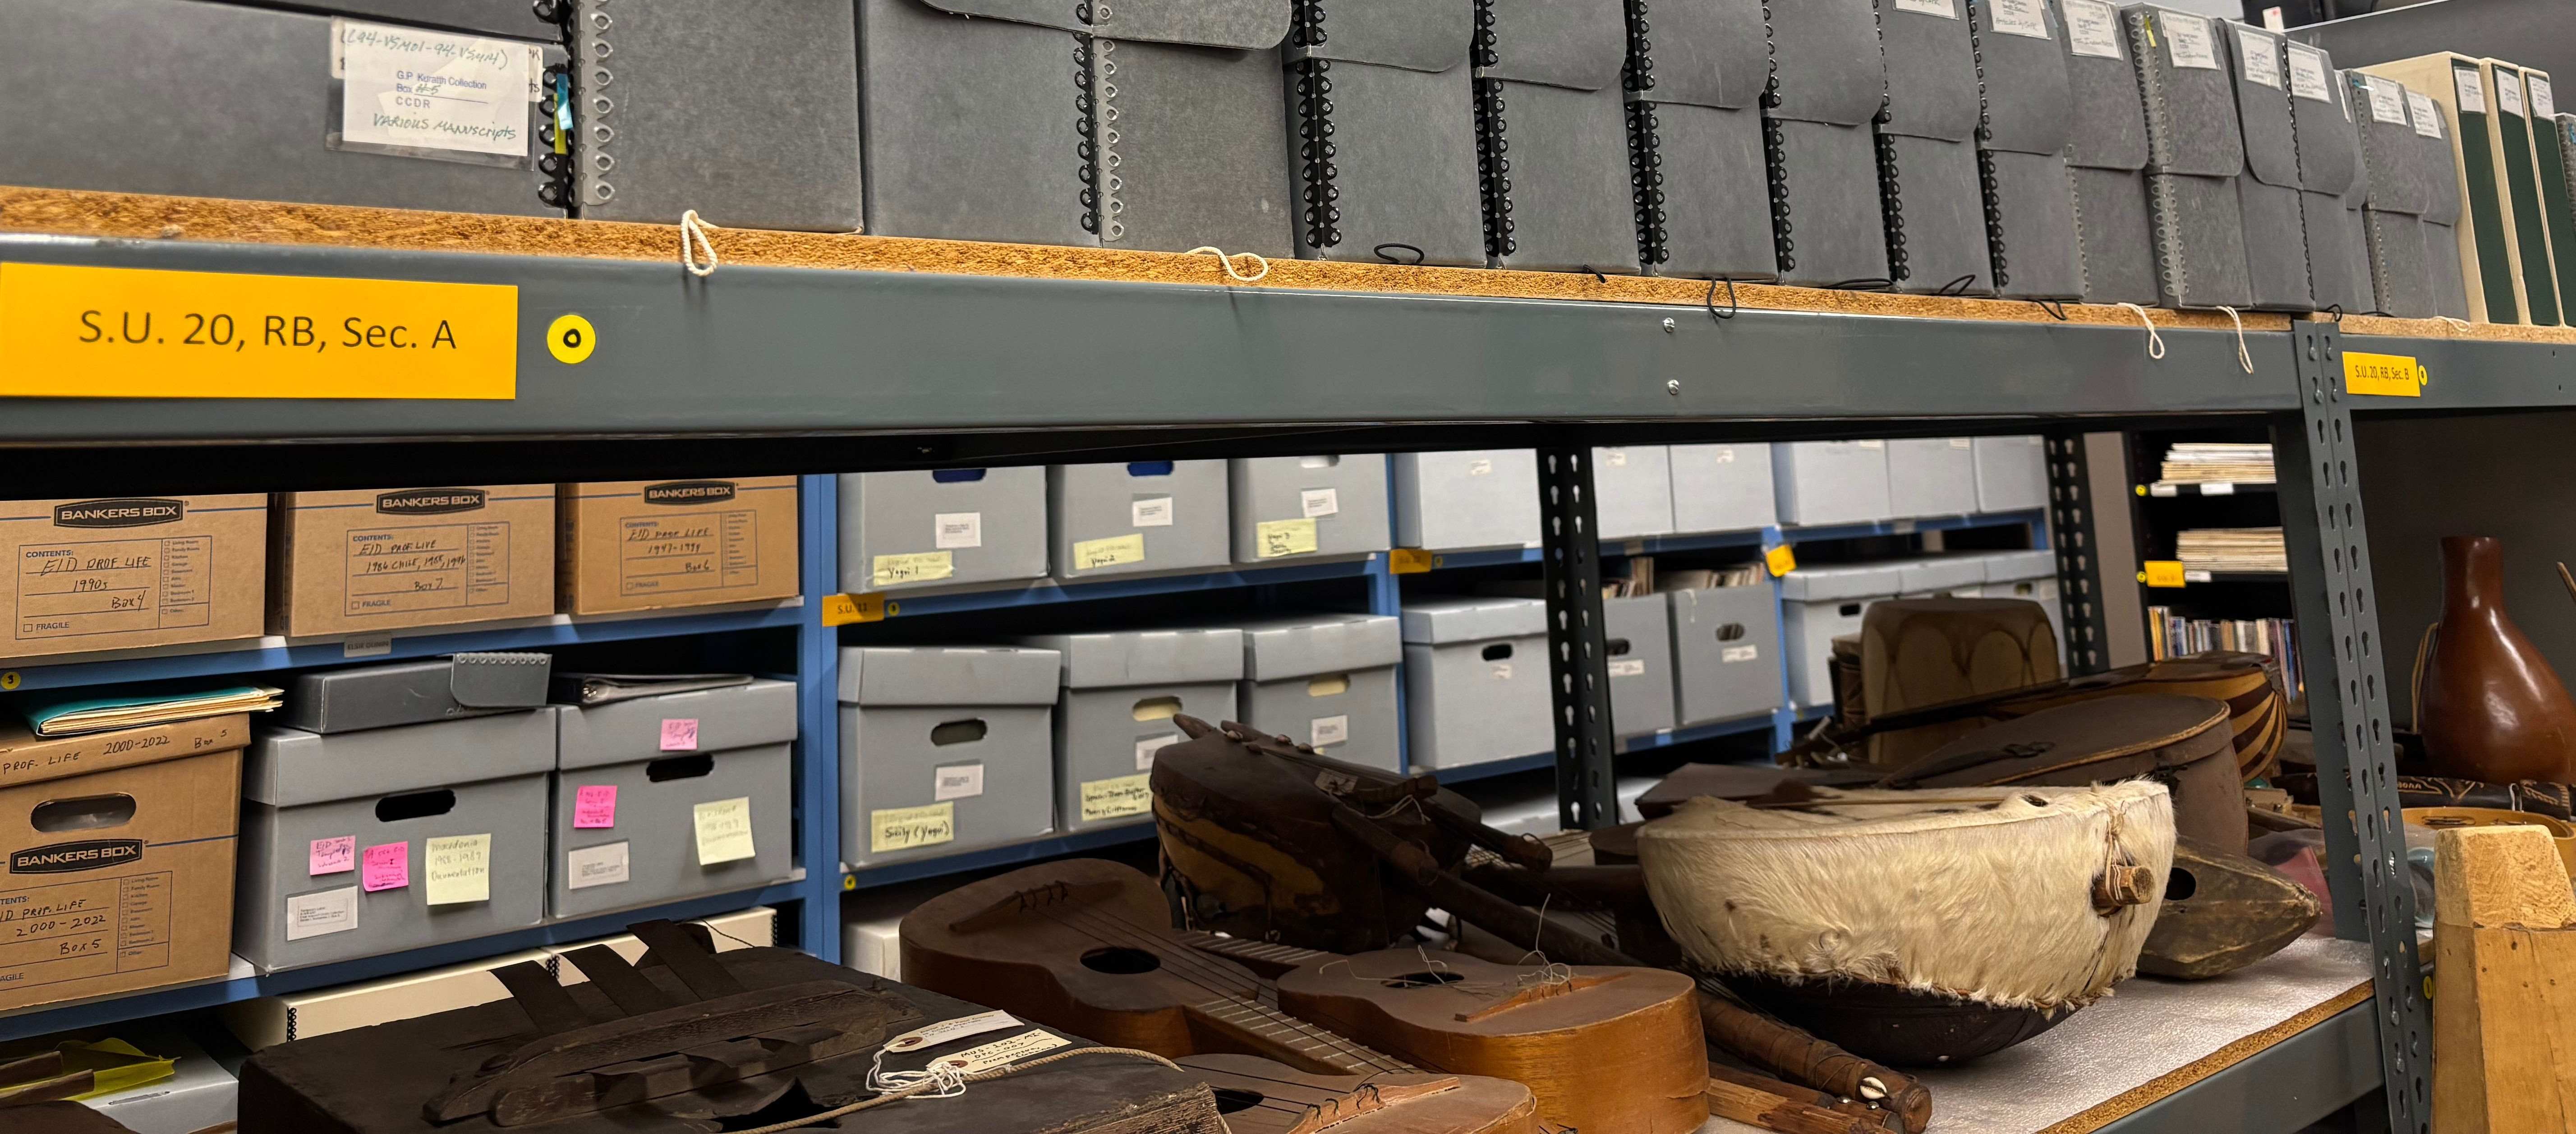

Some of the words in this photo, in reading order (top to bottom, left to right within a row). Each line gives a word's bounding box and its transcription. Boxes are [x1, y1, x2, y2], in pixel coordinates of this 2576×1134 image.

[396, 83, 412, 93] Box
[448, 77, 487, 89] Collection
[396, 96, 430, 109] CCDR
[373, 113, 429, 130] VARIOUS
[79, 310, 164, 344] S.U.
[182, 313, 244, 352] 20,
[264, 315, 326, 354] RB,
[342, 317, 418, 350] Sec.
[431, 320, 457, 350] A
[2355, 365, 2369, 378] S.U.
[2370, 366, 2379, 381] 20,
[2380, 367, 2391, 381] RB,
[2391, 367, 2403, 380] Sec.
[2405, 368, 2409, 380] B
[649, 488, 705, 499] BANKERS
[707, 486, 731, 496] BOX
[382, 496, 450, 508] BANKERS
[451, 494, 480, 505] BOX
[61, 508, 140, 520] BANKERS
[143, 506, 177, 516] BOX
[353, 534, 394, 542] CONTENTS:
[26, 549, 74, 558] CONTENTS:
[124, 556, 152, 569] LIFE
[704, 559, 709, 571] 6
[73, 578, 109, 593] 1990s
[414, 581, 432, 591] Box
[111, 596, 134, 609] Box
[137, 590, 147, 612] 4
[362, 599, 391, 608] FRAGILE
[837, 603, 855, 614] S.U.
[36, 622, 69, 631] FRAGILE
[47, 751, 82, 765] LIFE
[102, 736, 170, 756] 2000-2022
[17, 851, 98, 867] BANKERS
[101, 844, 137, 859] BOX
[56, 899, 87, 911] LIFE
[59, 942, 87, 955] Box
[92, 938, 102, 949] 5
